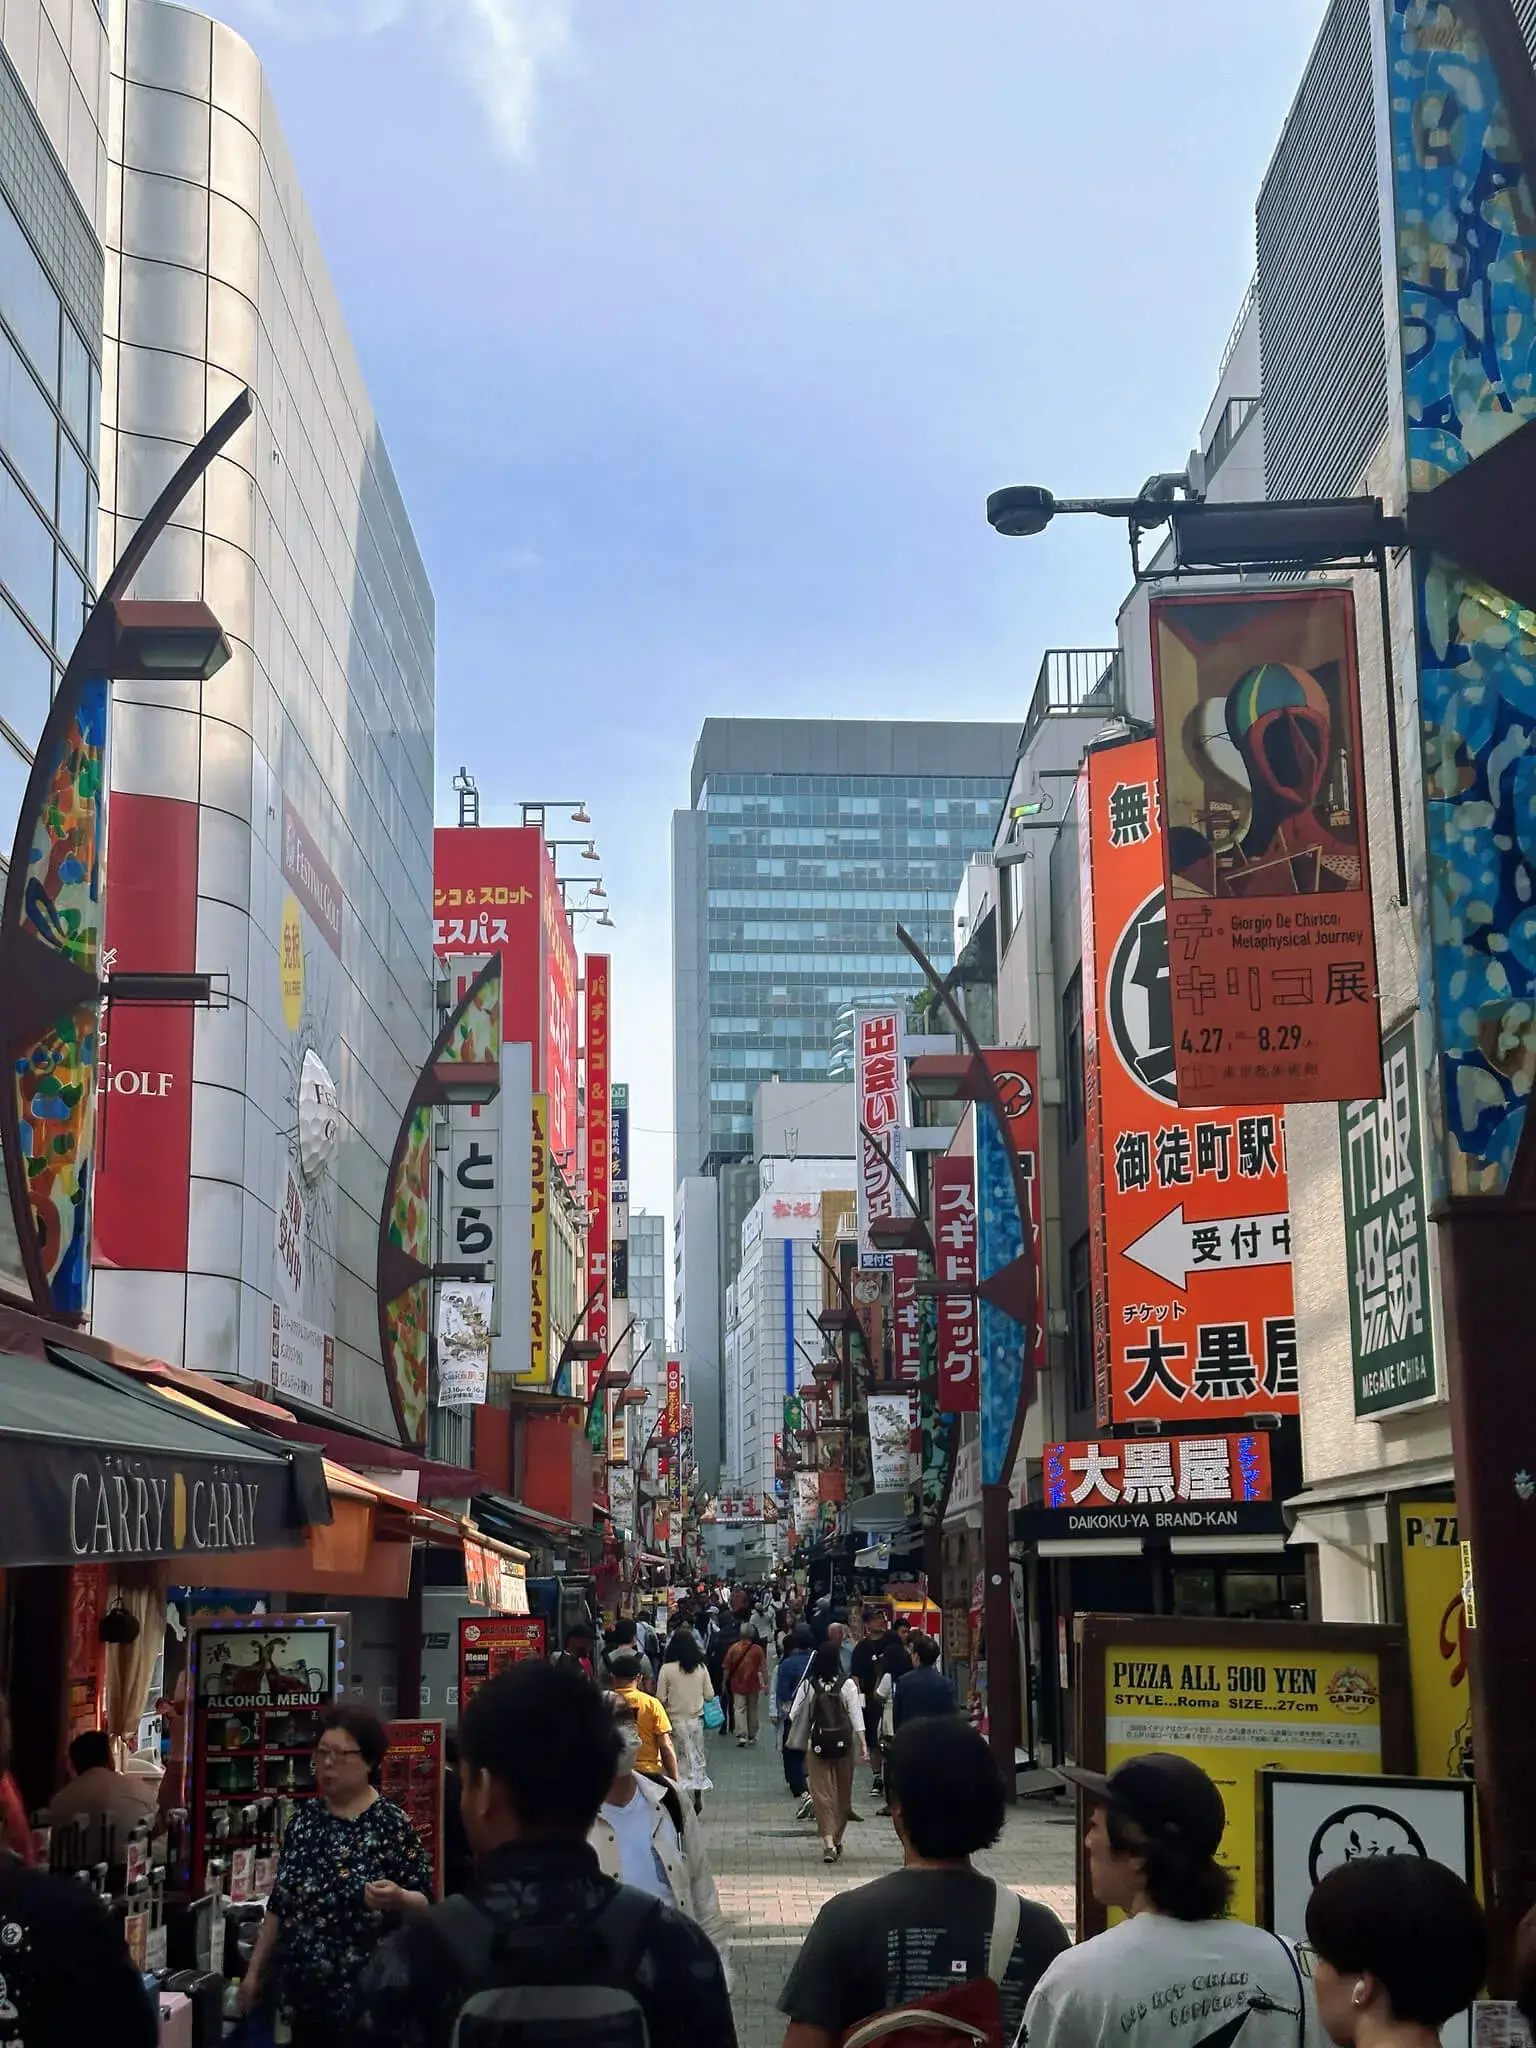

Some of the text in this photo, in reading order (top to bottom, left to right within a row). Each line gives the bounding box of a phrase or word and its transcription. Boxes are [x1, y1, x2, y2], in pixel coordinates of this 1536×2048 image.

[1108, 780, 1161, 848] 無
[433, 911, 509, 945] エスパス
[1231, 915, 1272, 931] Giorgio
[1276, 913, 1291, 928] De
[1232, 927, 1363, 950] Metaphysical Journey
[1177, 961, 1370, 1016] キリコ展
[1181, 1025, 1302, 1054] 4.27 8.29
[96, 1060, 174, 1097] GOLF
[862, 1015, 900, 1249] 出会いカフェ
[1114, 1114, 1287, 1194] 御徒町駅
[457, 1142, 495, 1255] とら
[940, 1184, 979, 1382] スギドラッグ
[1122, 1301, 1187, 1325] チケット
[1123, 1316, 1299, 1405] 大黒屋
[1361, 1354, 1427, 1399] MEGANE ICHIBA
[1069, 1439, 1232, 1505] 大黒屋
[71, 1472, 260, 1554] CARRY CARRY
[1069, 1510, 1238, 1529] DAIKOKU-YA BRAND-KAN
[1113, 1662, 1318, 1695] PIZZA ALL 500 YEN
[207, 1693, 320, 1708] ALCOHOL MENU
[1329, 1694, 1376, 1706] CAPUTO
